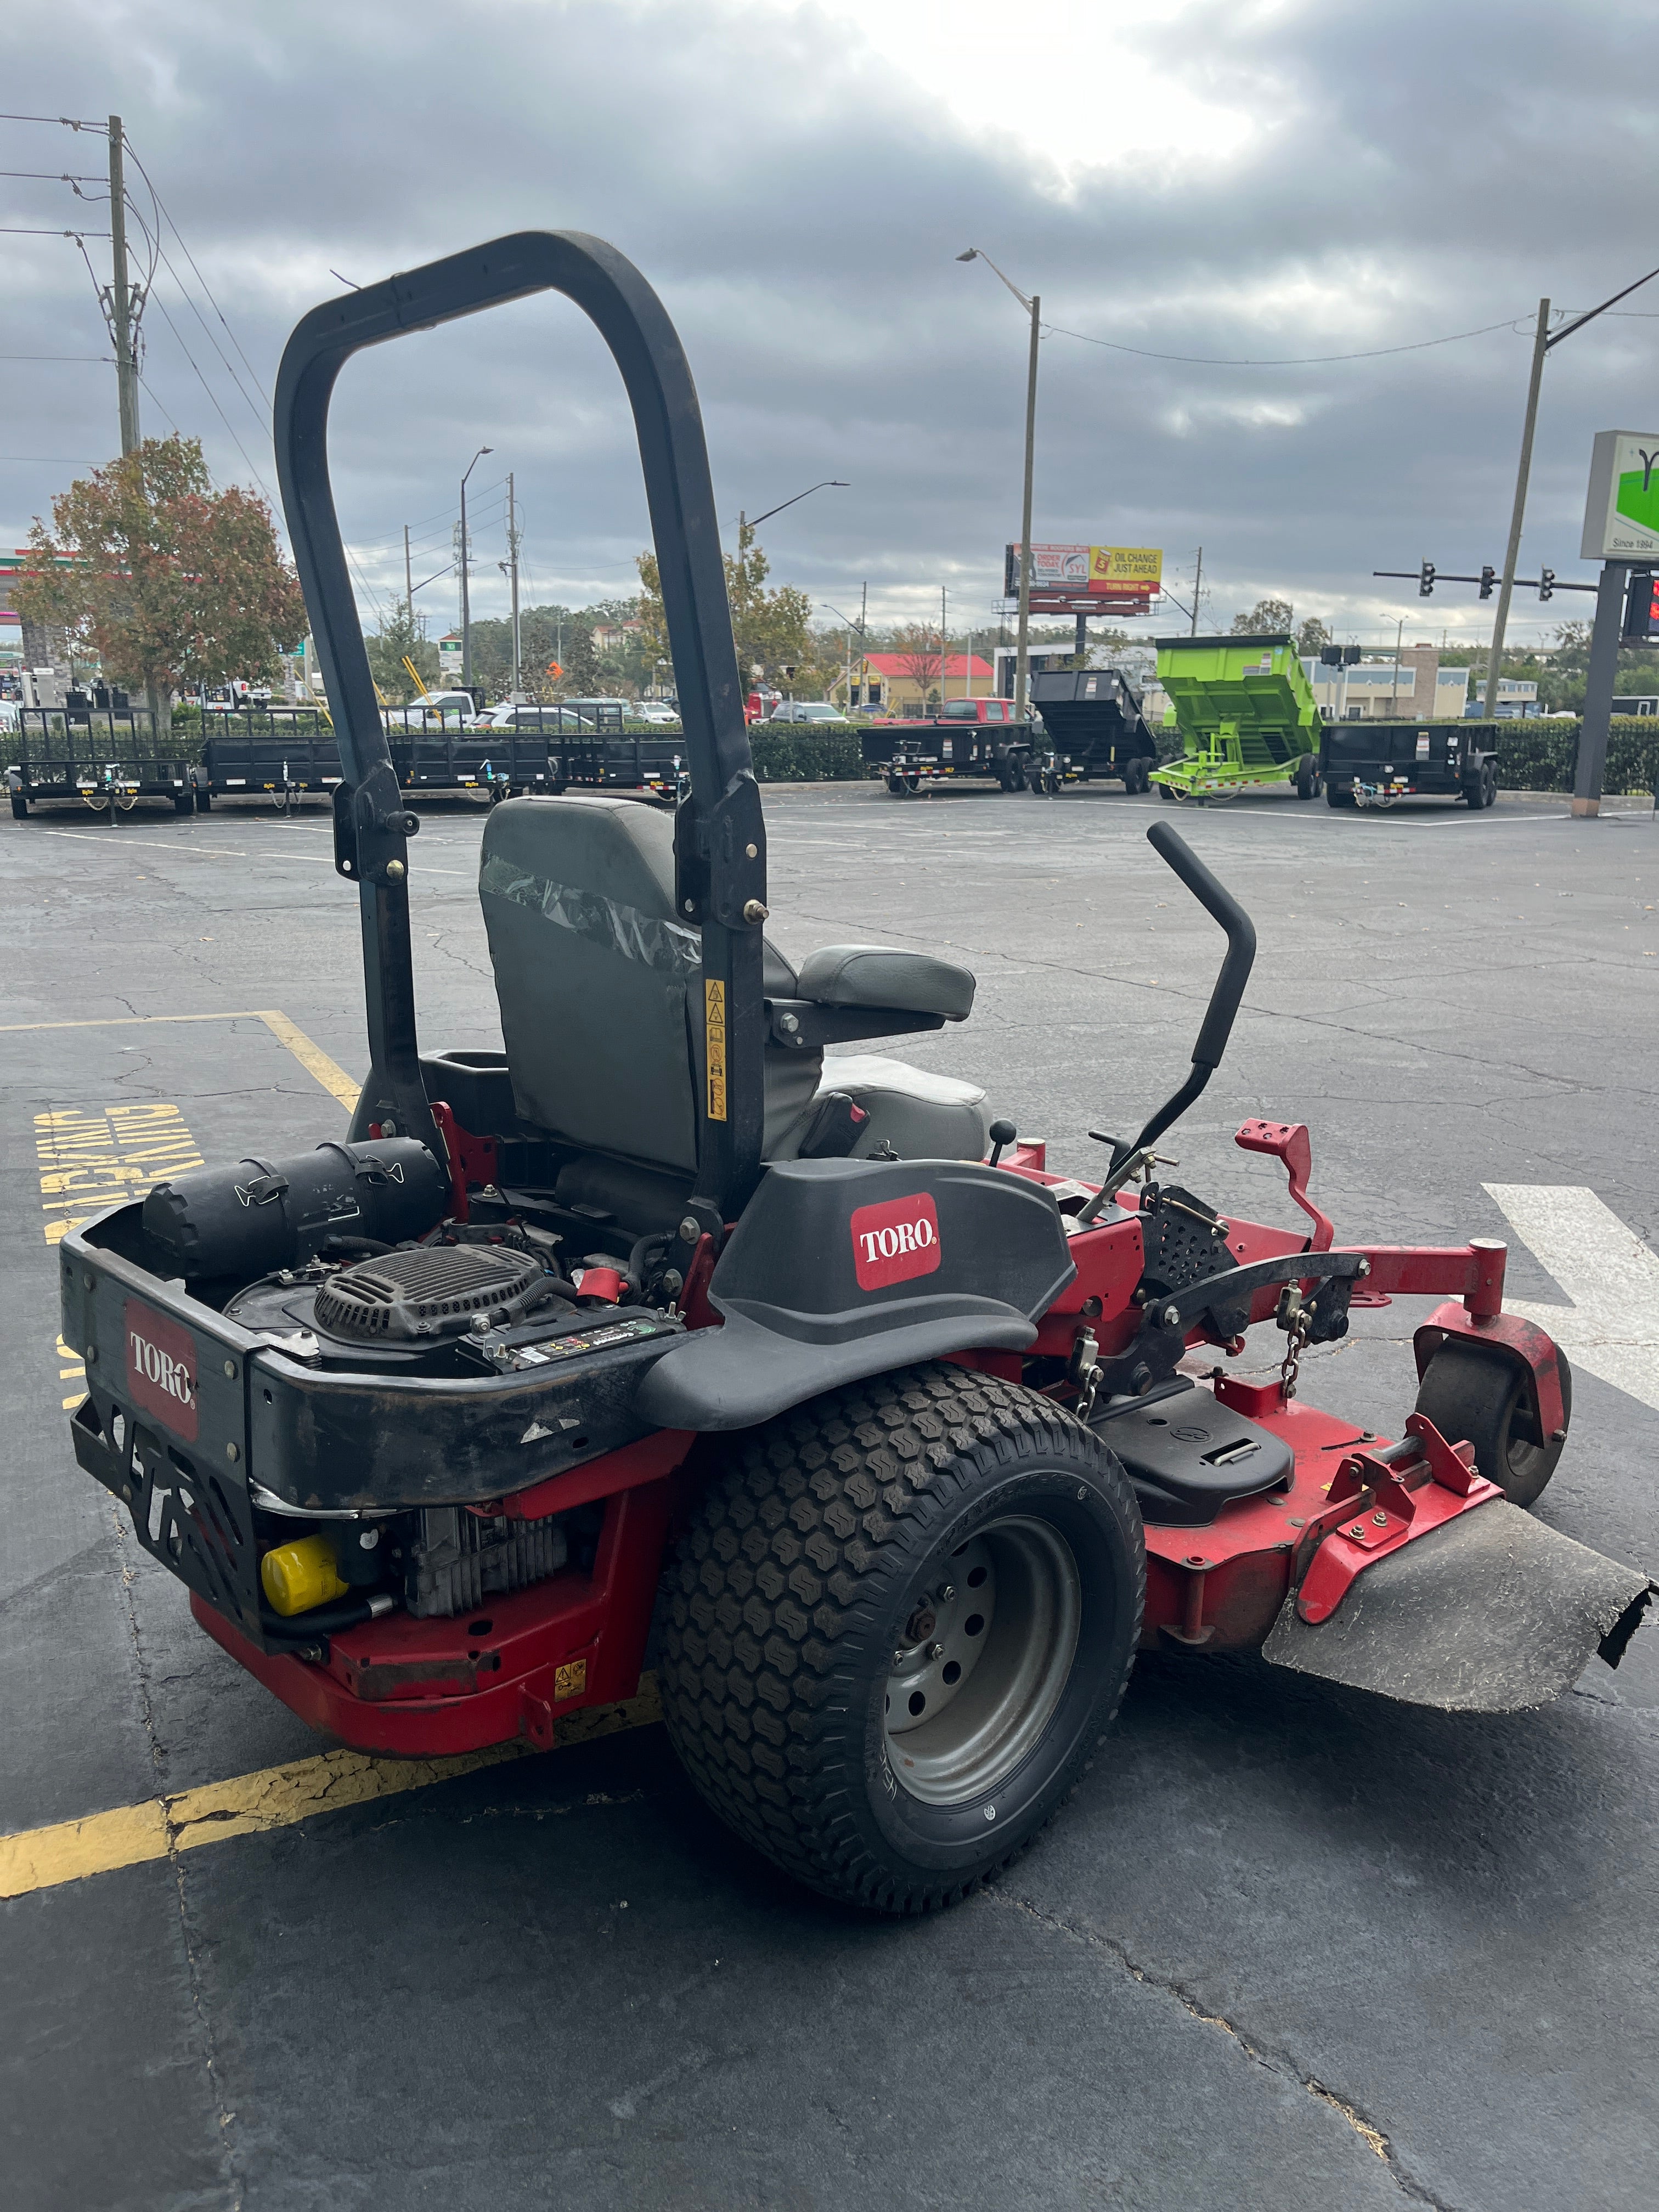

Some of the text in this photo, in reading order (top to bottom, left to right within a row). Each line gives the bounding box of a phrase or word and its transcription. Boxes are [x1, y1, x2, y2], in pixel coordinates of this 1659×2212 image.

[1612, 537, 1634, 548] Since
[1115, 552, 1126, 562] OIL
[1127, 553, 1158, 563] CHANGE
[1069, 563, 1087, 574] SYL
[1097, 560, 1106, 569] 5
[1114, 563, 1157, 574] JUST AHEAD
[1106, 582, 1122, 591] TURN
[859, 1218, 933, 1263] TORO
[130, 1330, 193, 1404] TORO
